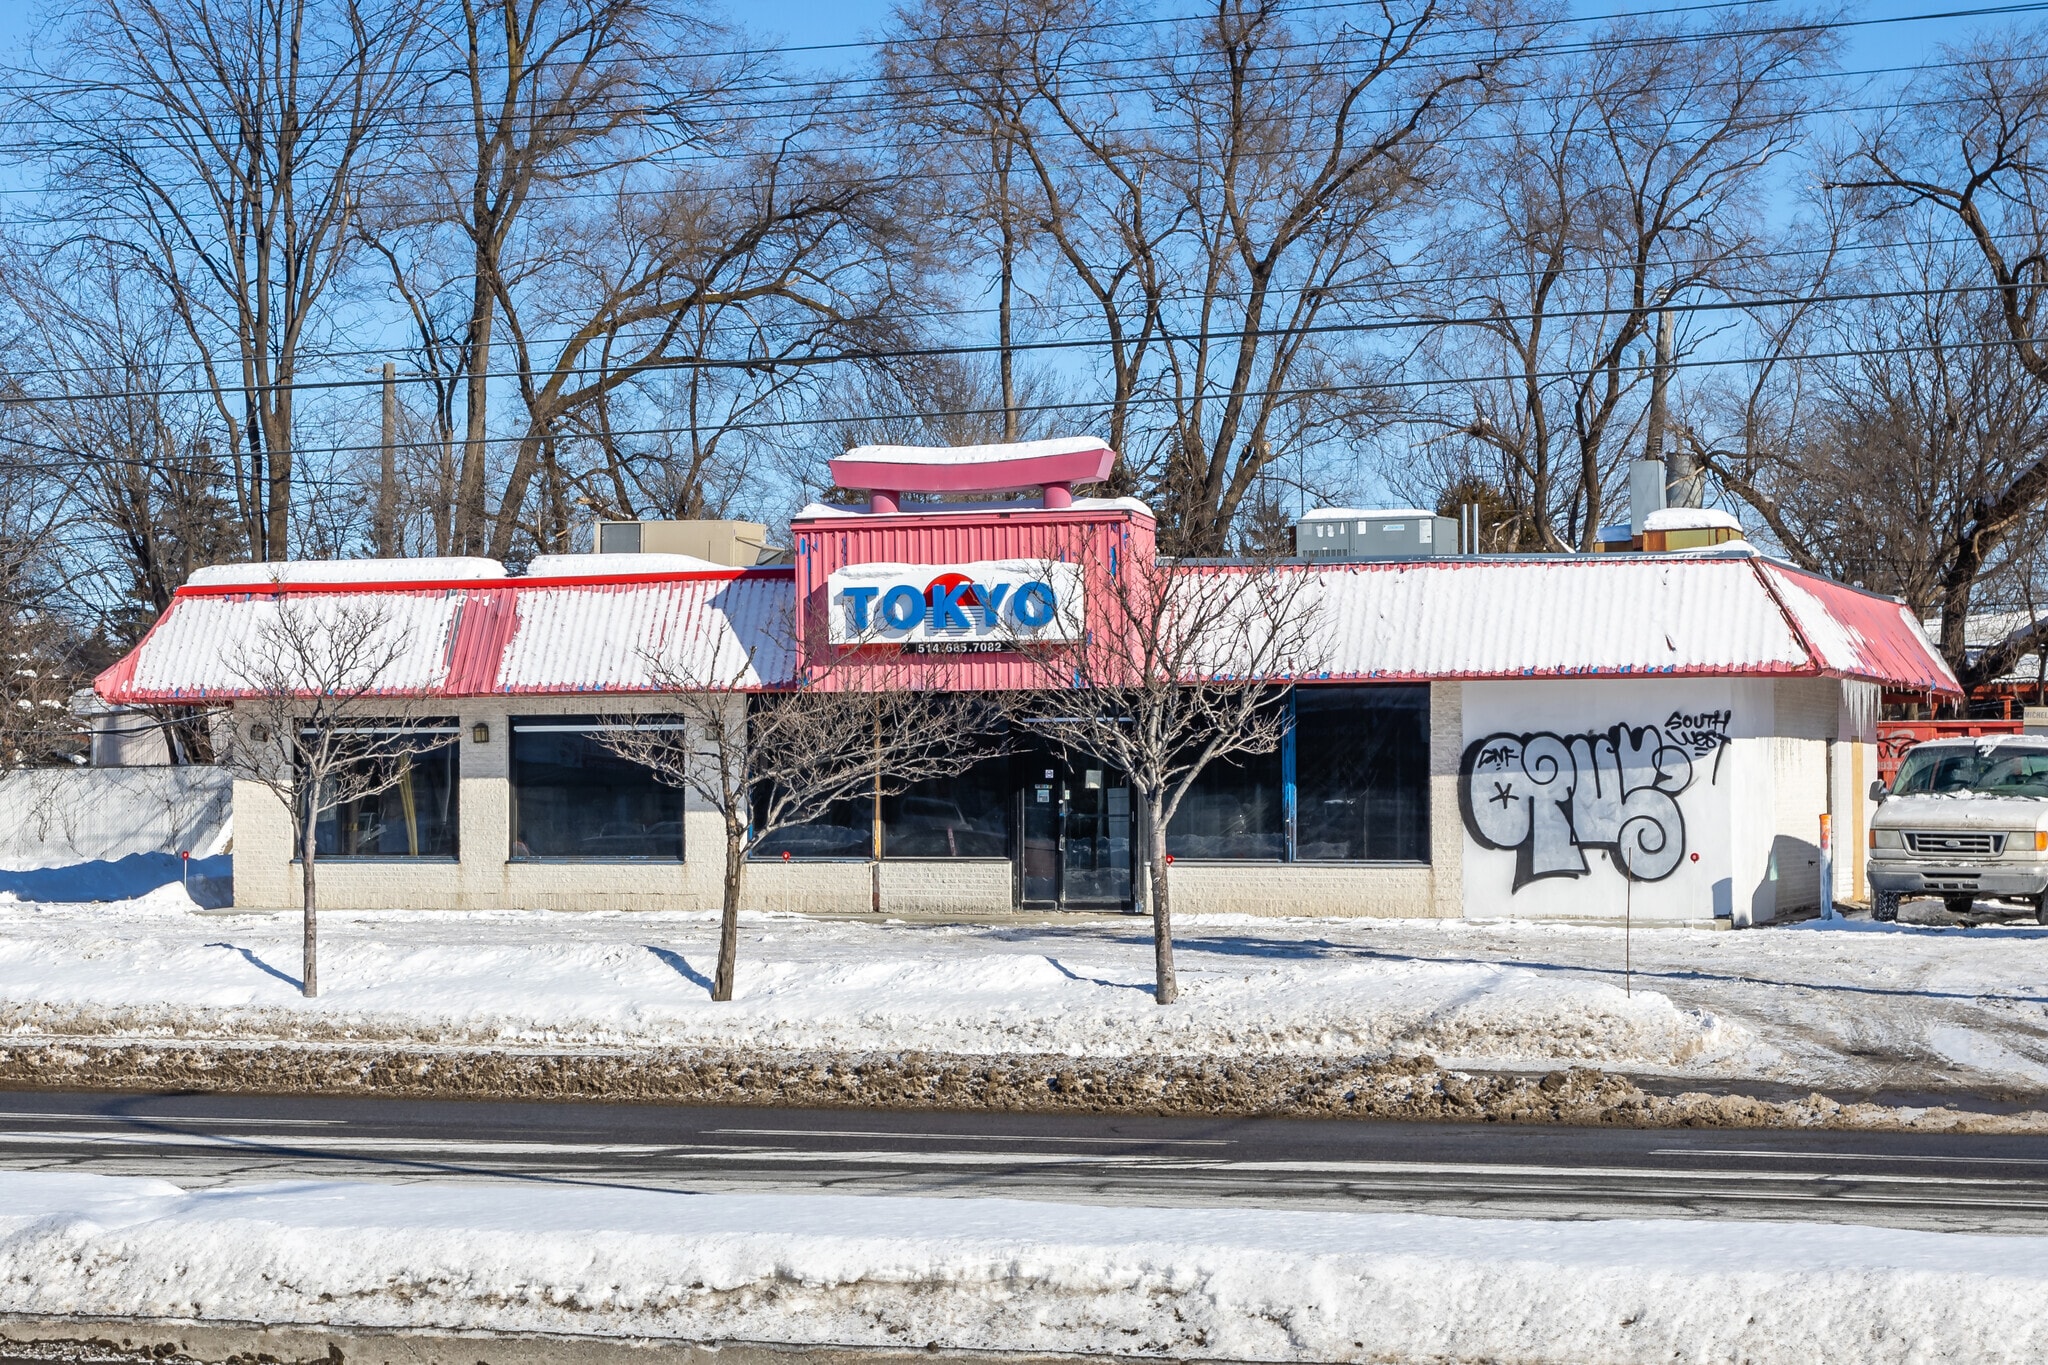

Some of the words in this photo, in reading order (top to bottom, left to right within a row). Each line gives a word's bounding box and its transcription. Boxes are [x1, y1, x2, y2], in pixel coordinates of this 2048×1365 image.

[843, 582, 1056, 631] TOKYO
[917, 642, 1002, 653] 514.685.7082
[1664, 709, 1732, 734] SOUTH
